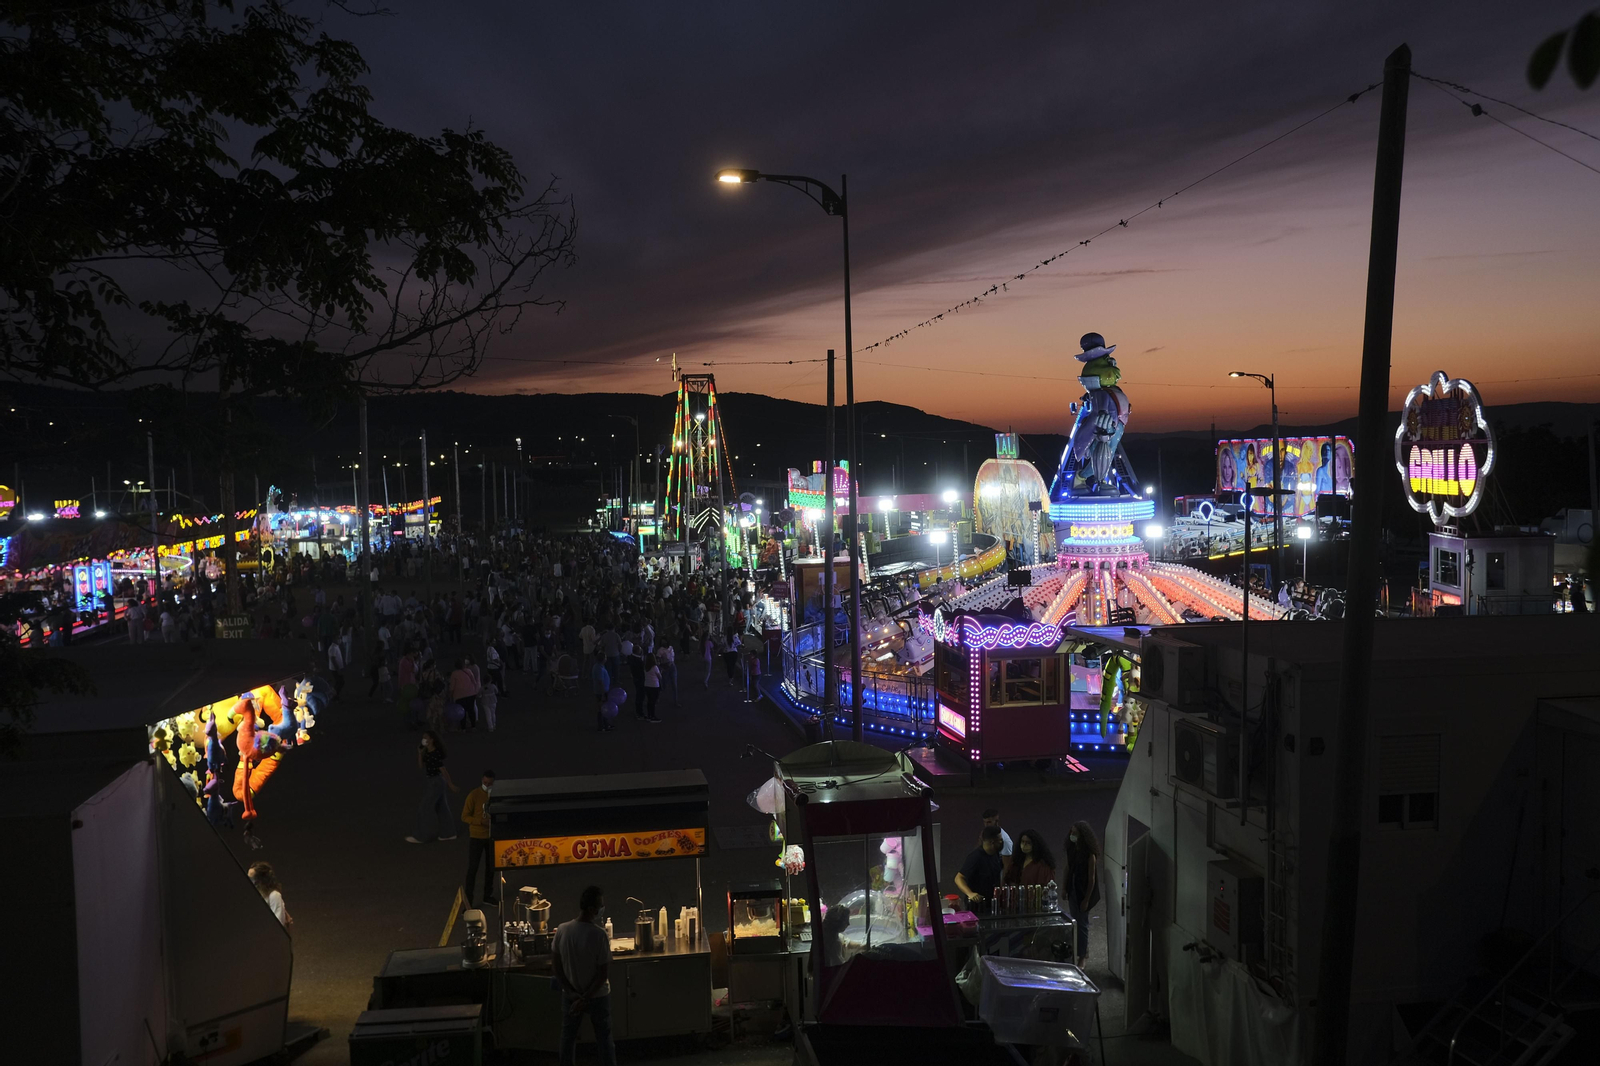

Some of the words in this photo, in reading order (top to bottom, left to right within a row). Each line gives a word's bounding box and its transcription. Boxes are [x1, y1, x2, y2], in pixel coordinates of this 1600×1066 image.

[1409, 443, 1476, 496] GRILLO
[216, 617, 249, 627] SALIDA
[222, 629, 244, 639] EXIT
[633, 830, 682, 845] GOFRES
[572, 836, 632, 860] GEMA
